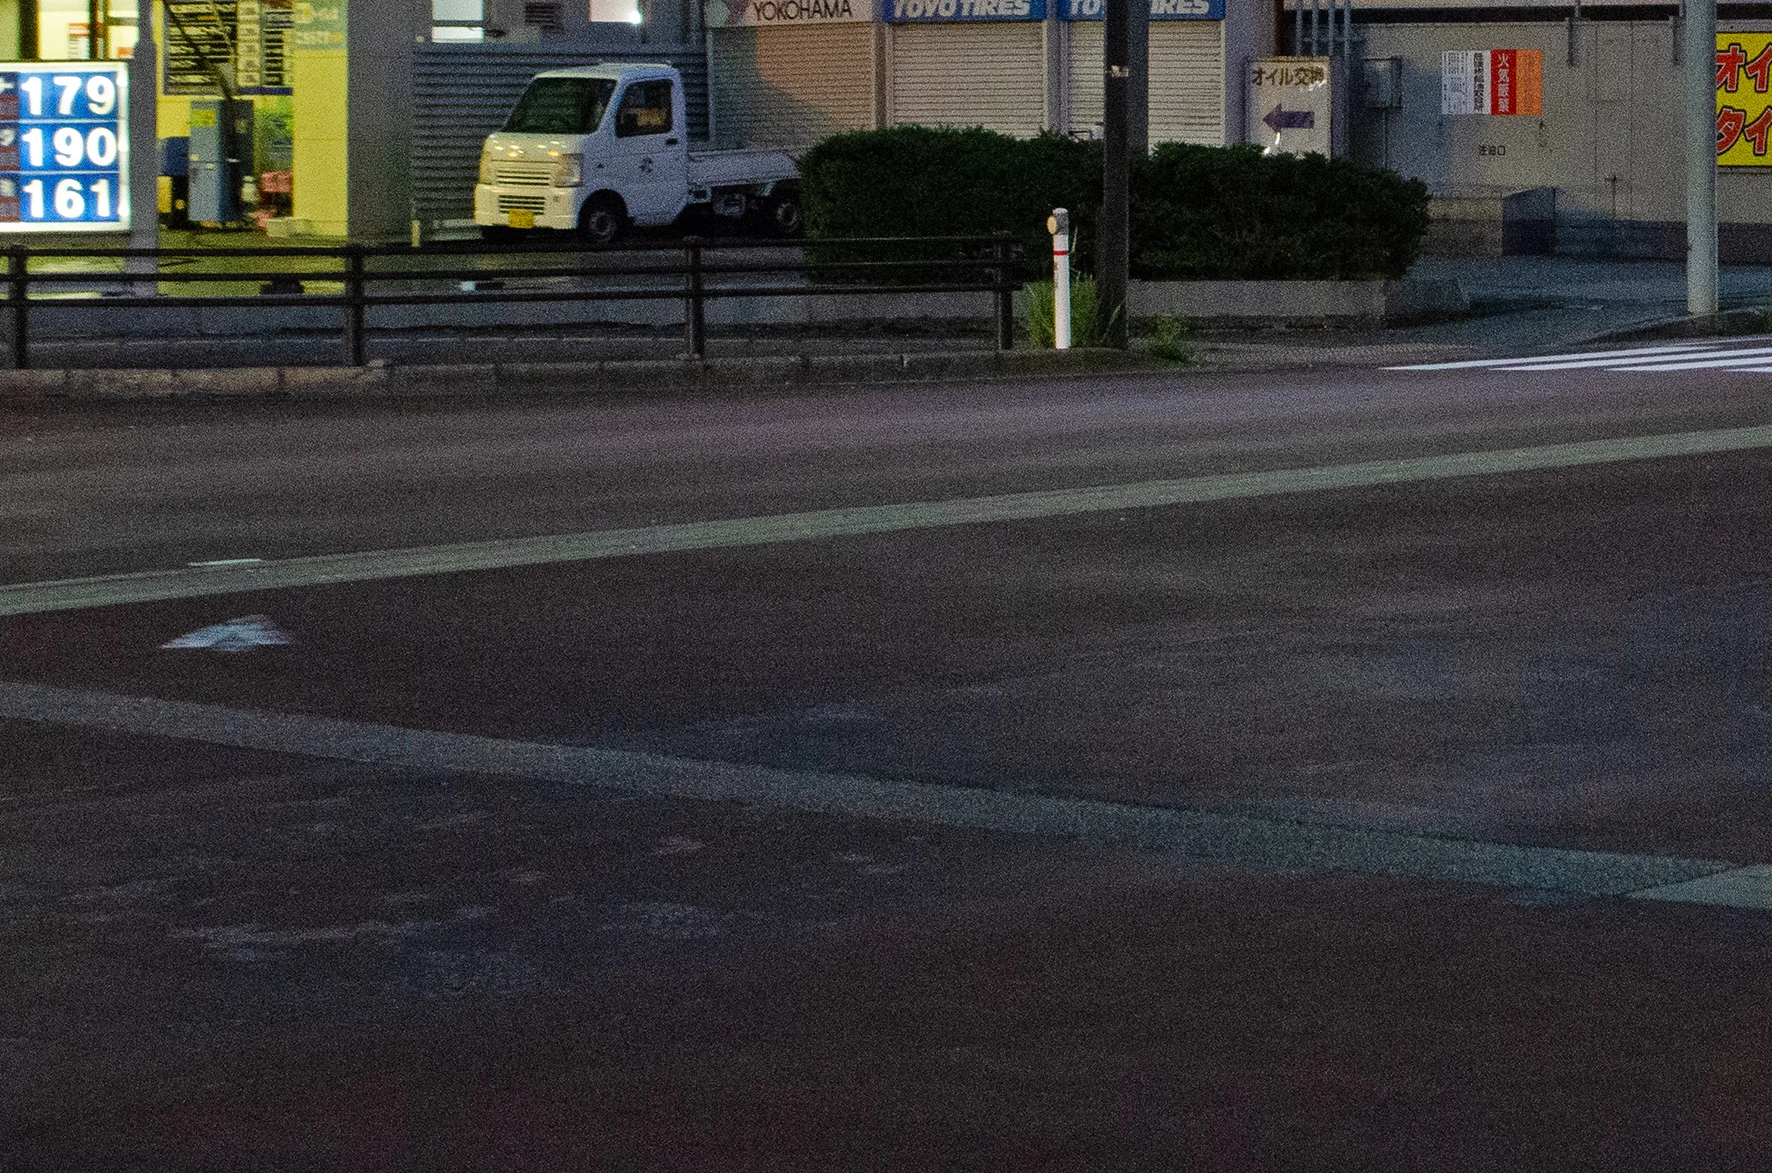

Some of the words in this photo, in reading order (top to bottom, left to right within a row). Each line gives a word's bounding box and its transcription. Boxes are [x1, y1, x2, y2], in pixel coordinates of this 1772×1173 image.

[20, 75, 117, 116] 179
[21, 127, 118, 168] 190
[22, 178, 112, 219] 161
